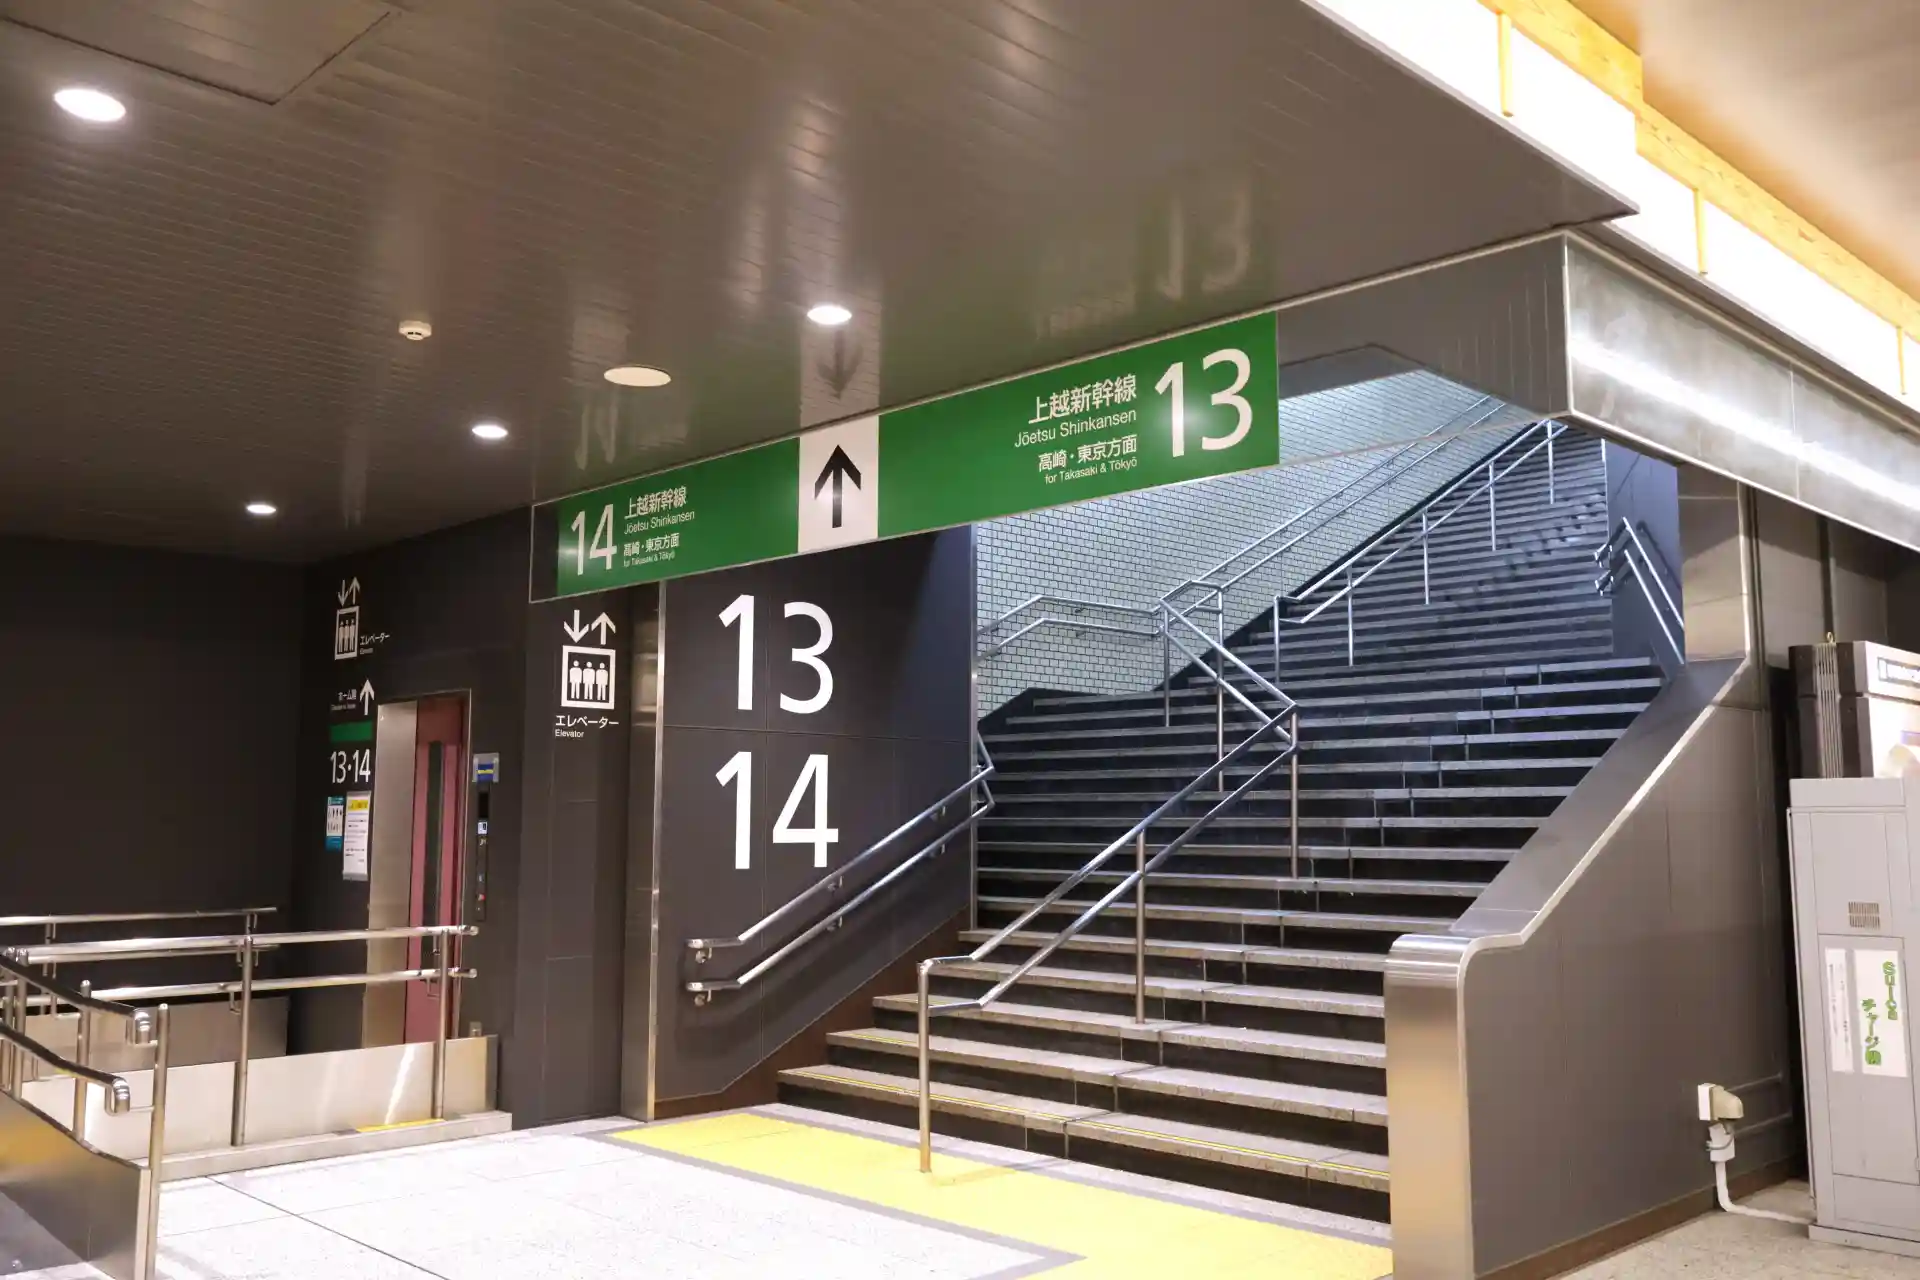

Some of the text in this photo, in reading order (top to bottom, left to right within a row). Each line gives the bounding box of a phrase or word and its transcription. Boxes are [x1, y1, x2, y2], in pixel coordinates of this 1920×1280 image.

[1028, 373, 1138, 425] 上越新幹線
[1154, 348, 1253, 458] 13
[1014, 409, 1137, 448] Jōetsu Shinkansen
[1038, 433, 1138, 473] 高崎・東京方面
[1044, 456, 1138, 485] for Takasaki & Tōkyō
[623, 485, 687, 520] 上越新幹線
[650, 510, 695, 529] Shinkansen
[570, 503, 618, 576] 14
[359, 632, 391, 646] エレベーター
[718, 594, 835, 714] 13
[554, 728, 585, 738] Elevator
[555, 714, 620, 729] エレベーター
[715, 751, 839, 869] 14
